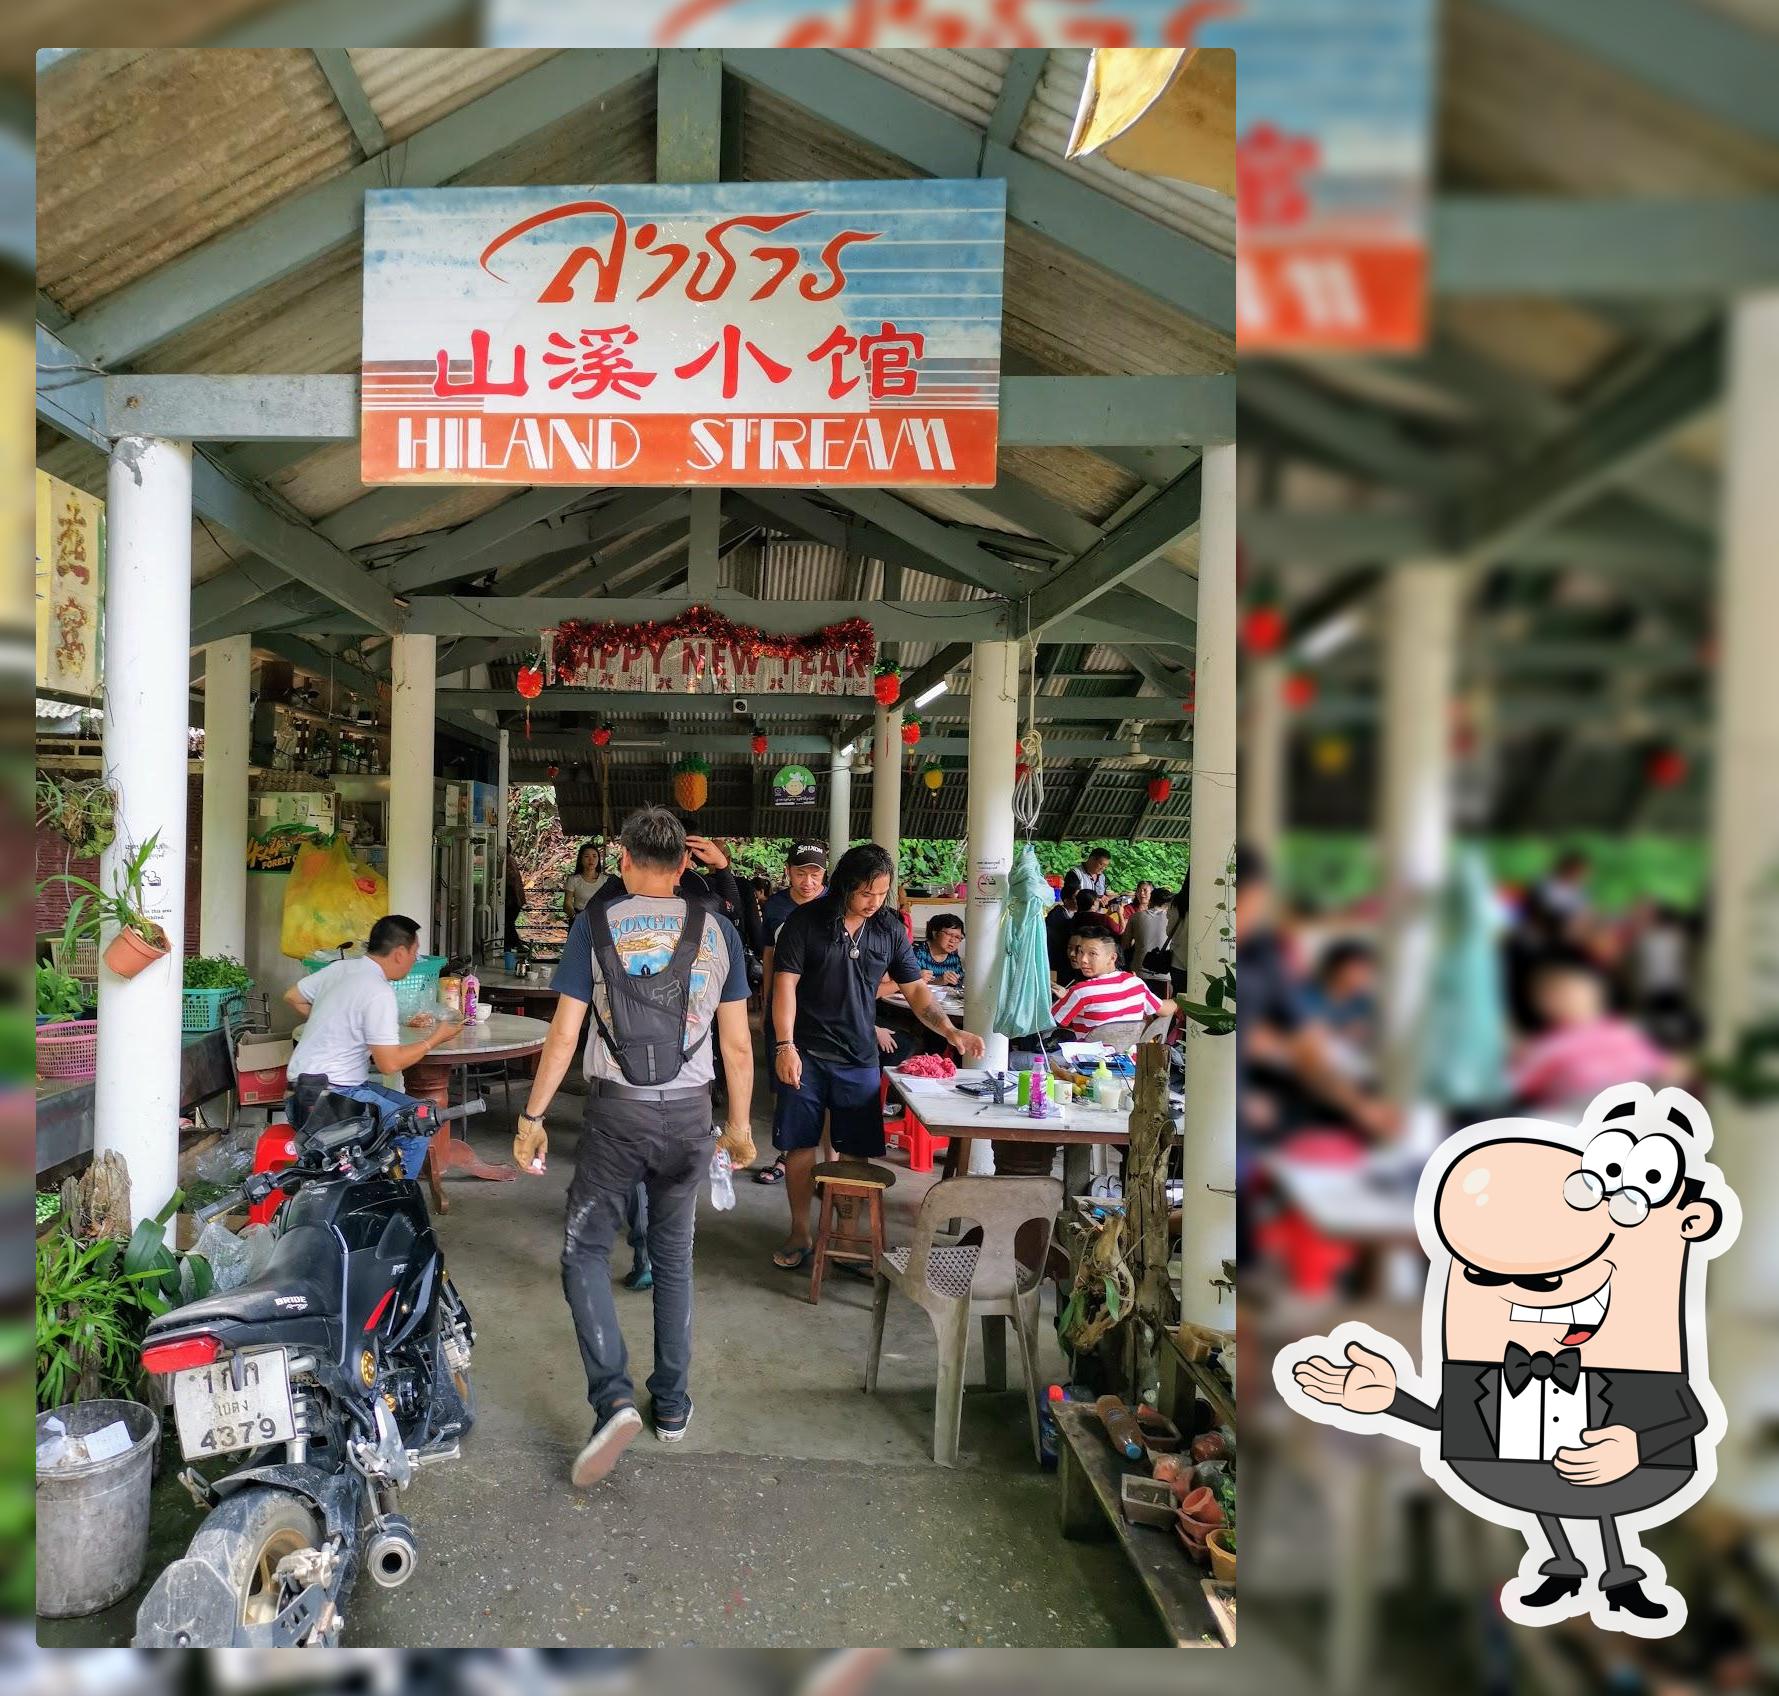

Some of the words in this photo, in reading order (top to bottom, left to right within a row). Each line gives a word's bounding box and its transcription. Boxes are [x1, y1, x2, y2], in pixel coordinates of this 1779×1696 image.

[480, 201, 884, 303] ลำธาร
[434, 322, 926, 401] 山溪小馆
[398, 417, 641, 471] HILAND
[687, 417, 956, 472] STREAM
[682, 642, 759, 678] NEW
[274, 1296, 307, 1306] BRIDE
[200, 1417, 277, 1450] 4379
